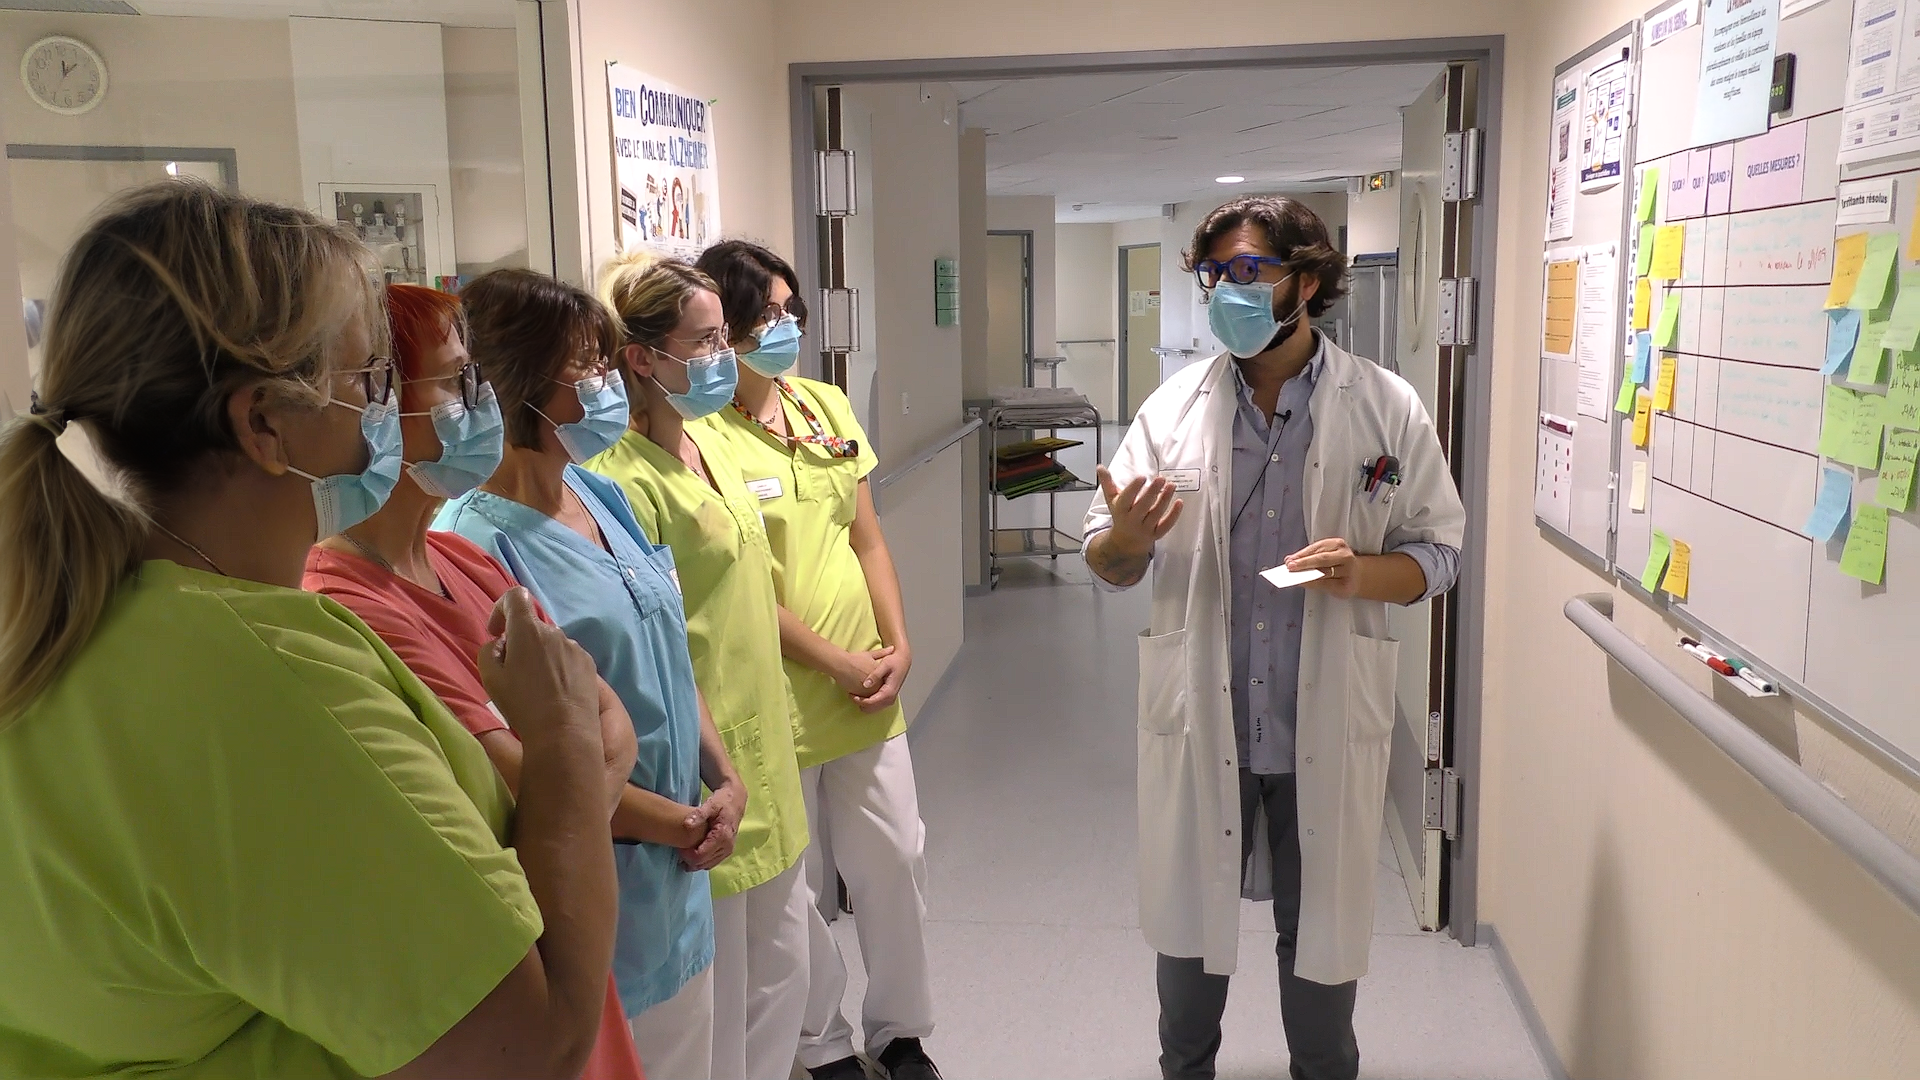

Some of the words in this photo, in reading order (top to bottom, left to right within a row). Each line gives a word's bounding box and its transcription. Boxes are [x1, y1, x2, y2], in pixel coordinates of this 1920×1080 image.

[615, 87, 637, 119] BIEN
[639, 84, 705, 137] COMMUNIQUER
[615, 136, 632, 158] AVEC
[669, 136, 708, 170] ALZHEIMER
[1747, 160, 1769, 178] QUELLES
[1770, 155, 1795, 174] MESURES
[1796, 153, 1800, 167] ?
[1692, 178, 1701, 190] QUI
[1710, 171, 1726, 185] QUAND
[1841, 194, 1865, 209] Irritants
[1866, 192, 1887, 204] résolus
